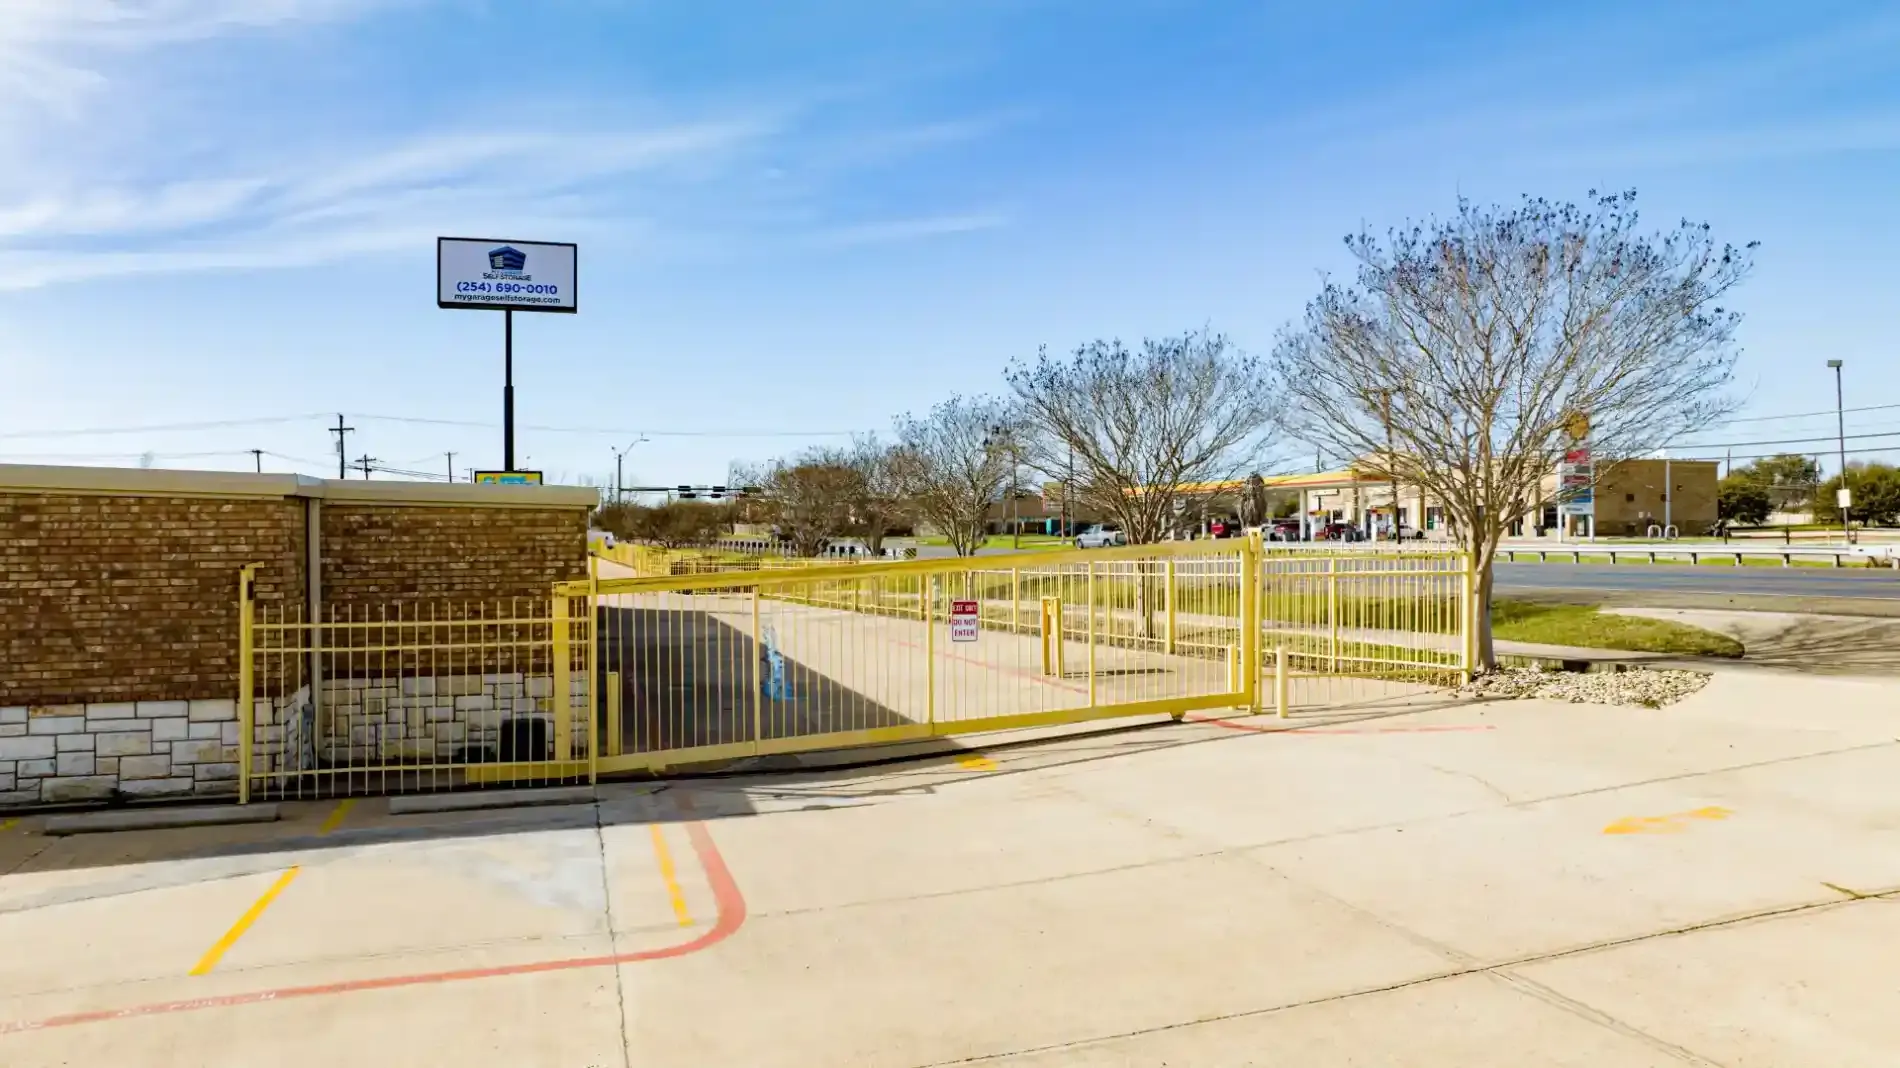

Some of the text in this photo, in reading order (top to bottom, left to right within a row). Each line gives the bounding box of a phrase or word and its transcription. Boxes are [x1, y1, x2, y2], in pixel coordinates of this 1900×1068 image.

[457, 282, 558, 294] (254) 690-0010
[454, 294, 560, 304] mygarageselfstorage.com
